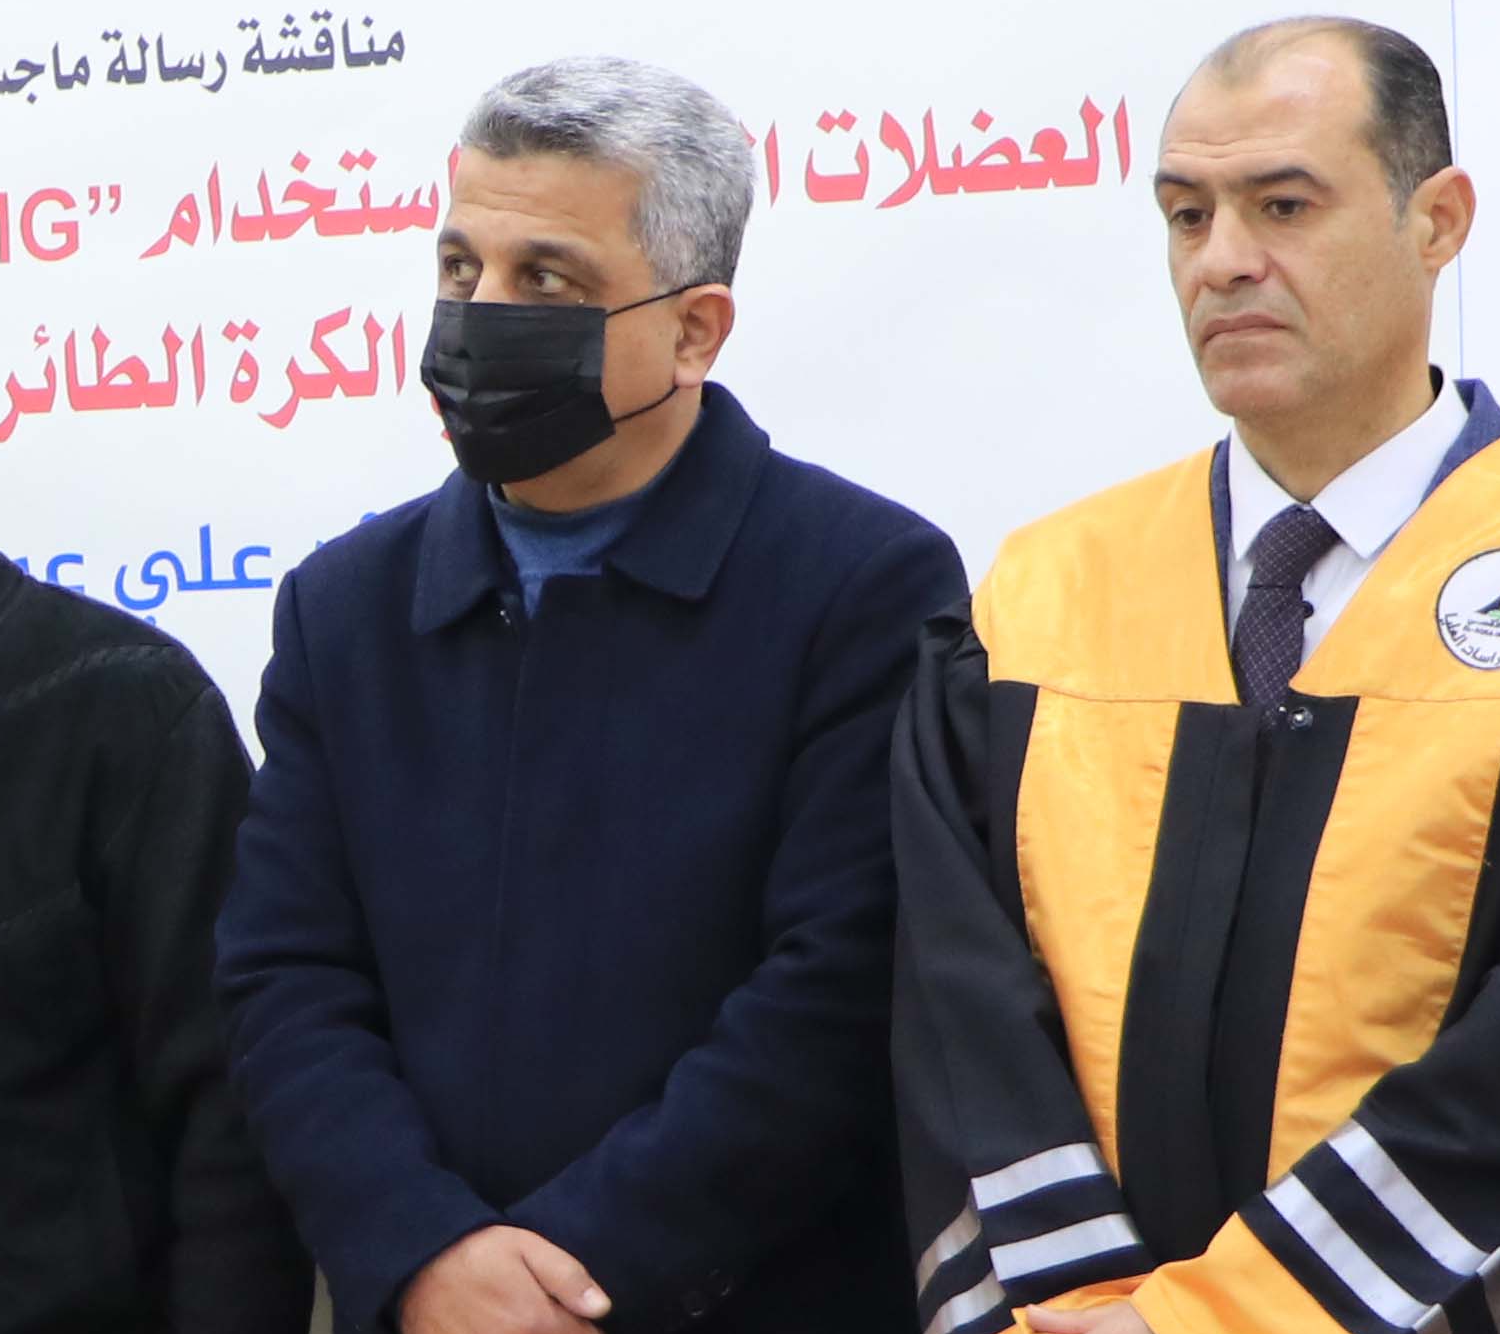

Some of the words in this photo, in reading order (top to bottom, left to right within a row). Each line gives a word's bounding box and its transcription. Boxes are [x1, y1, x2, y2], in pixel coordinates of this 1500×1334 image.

[107, 28, 227, 94] رسالة
[241, 9, 406, 73] مناقشة
[803, 94, 1133, 209] العضلات
[223, 306, 406, 428] الكرة
[113, 523, 273, 627] علي
